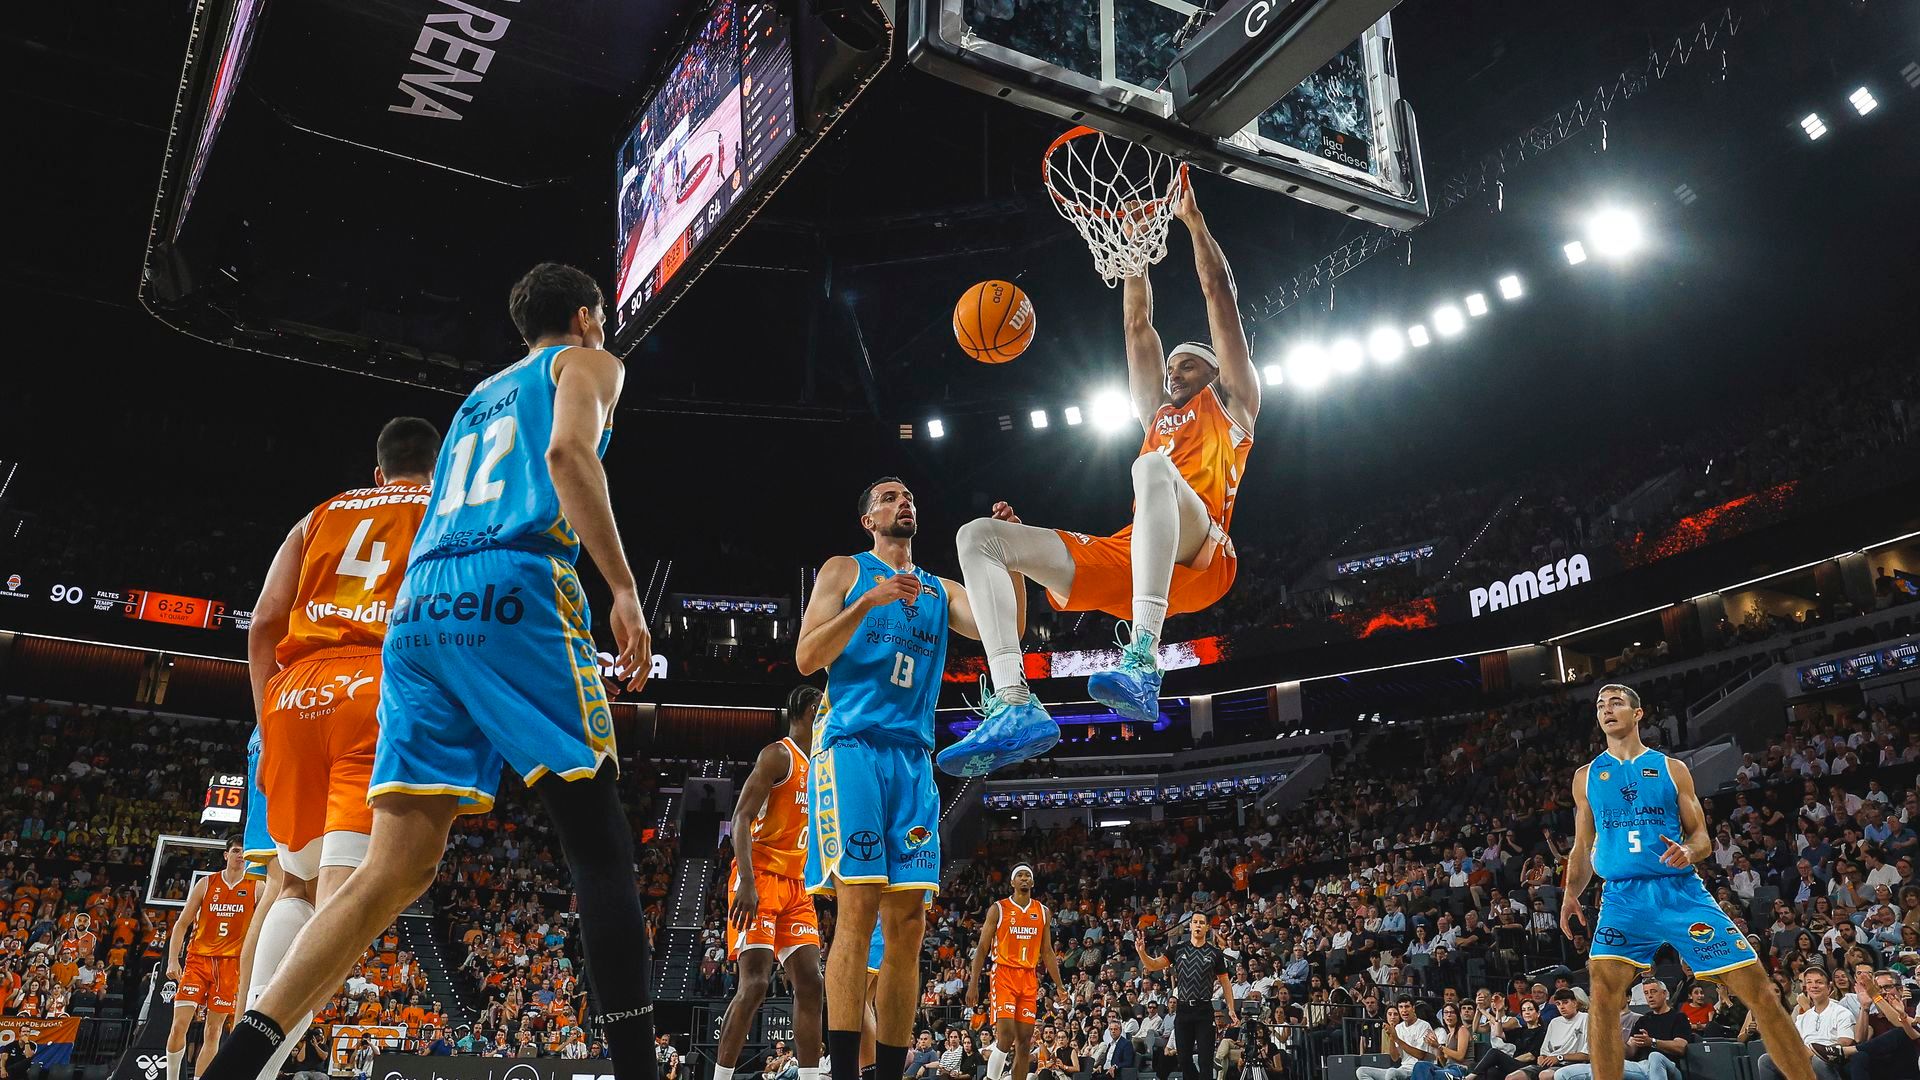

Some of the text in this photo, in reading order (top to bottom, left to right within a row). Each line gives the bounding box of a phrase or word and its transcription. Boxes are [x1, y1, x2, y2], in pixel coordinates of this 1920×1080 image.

[387, 0, 520, 121] RENA
[1323, 135, 1344, 151] liga
[1324, 148, 1368, 170] endesa
[708, 199, 721, 224] 64
[631, 290, 642, 315] 90
[993, 286, 1004, 304] acb
[436, 415, 516, 516] 12
[328, 494, 430, 511] PAMESA
[335, 518, 391, 591] 4
[1469, 553, 1591, 618] PAMESA
[50, 584, 83, 604] 90
[97, 591, 135, 602] FALTES 2
[125, 605, 132, 613] 0
[158, 599, 195, 615] 6:25
[218, 607, 225, 615] 2
[890, 651, 915, 688] 13
[275, 684, 335, 711] MGS
[299, 706, 336, 720] Seguros
[219, 775, 244, 786] 6:25
[215, 788, 240, 807] 15
[1628, 831, 1642, 853] 5
[916, 858, 936, 870] Mar
[209, 903, 244, 913] VALENCIA
[218, 922, 228, 937] 5
[1009, 926, 1037, 935] VALENCIA
[1022, 946, 1027, 962] 1
[1693, 941, 1727, 954] Poema
[1701, 948, 1731, 961] del Mar
[241, 1014, 281, 1046] PALDING
[767, 1030, 795, 1040] SALID
